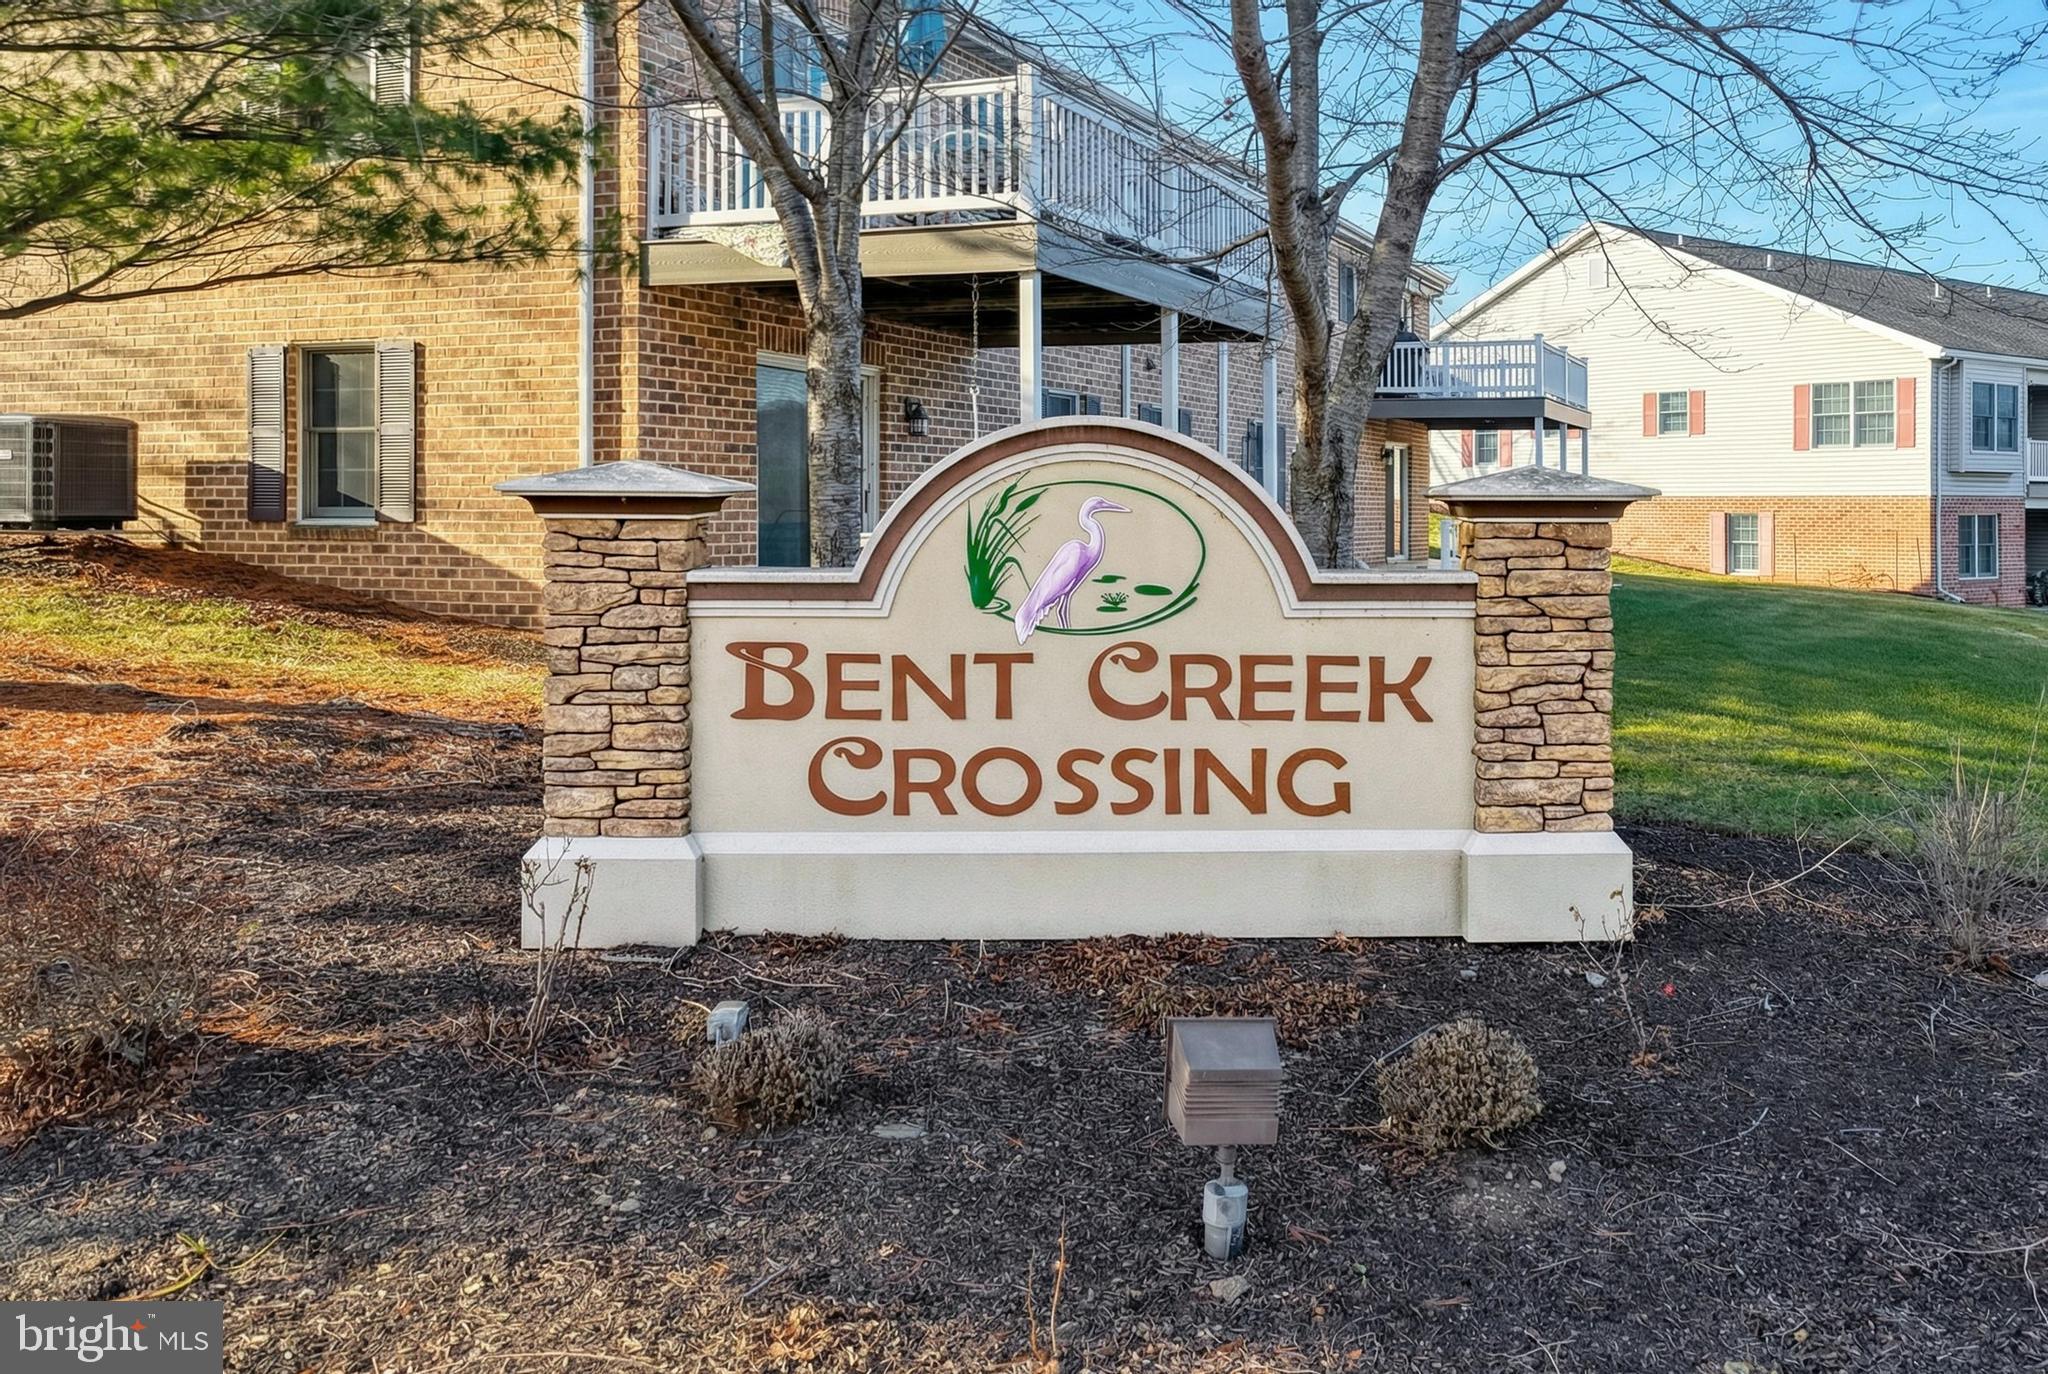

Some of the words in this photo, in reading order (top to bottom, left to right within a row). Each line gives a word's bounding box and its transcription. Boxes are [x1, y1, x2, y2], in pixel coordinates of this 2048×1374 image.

[725, 641, 1035, 722] BENT
[1087, 641, 1434, 723] CREEK
[807, 736, 1352, 818] CROSSING
